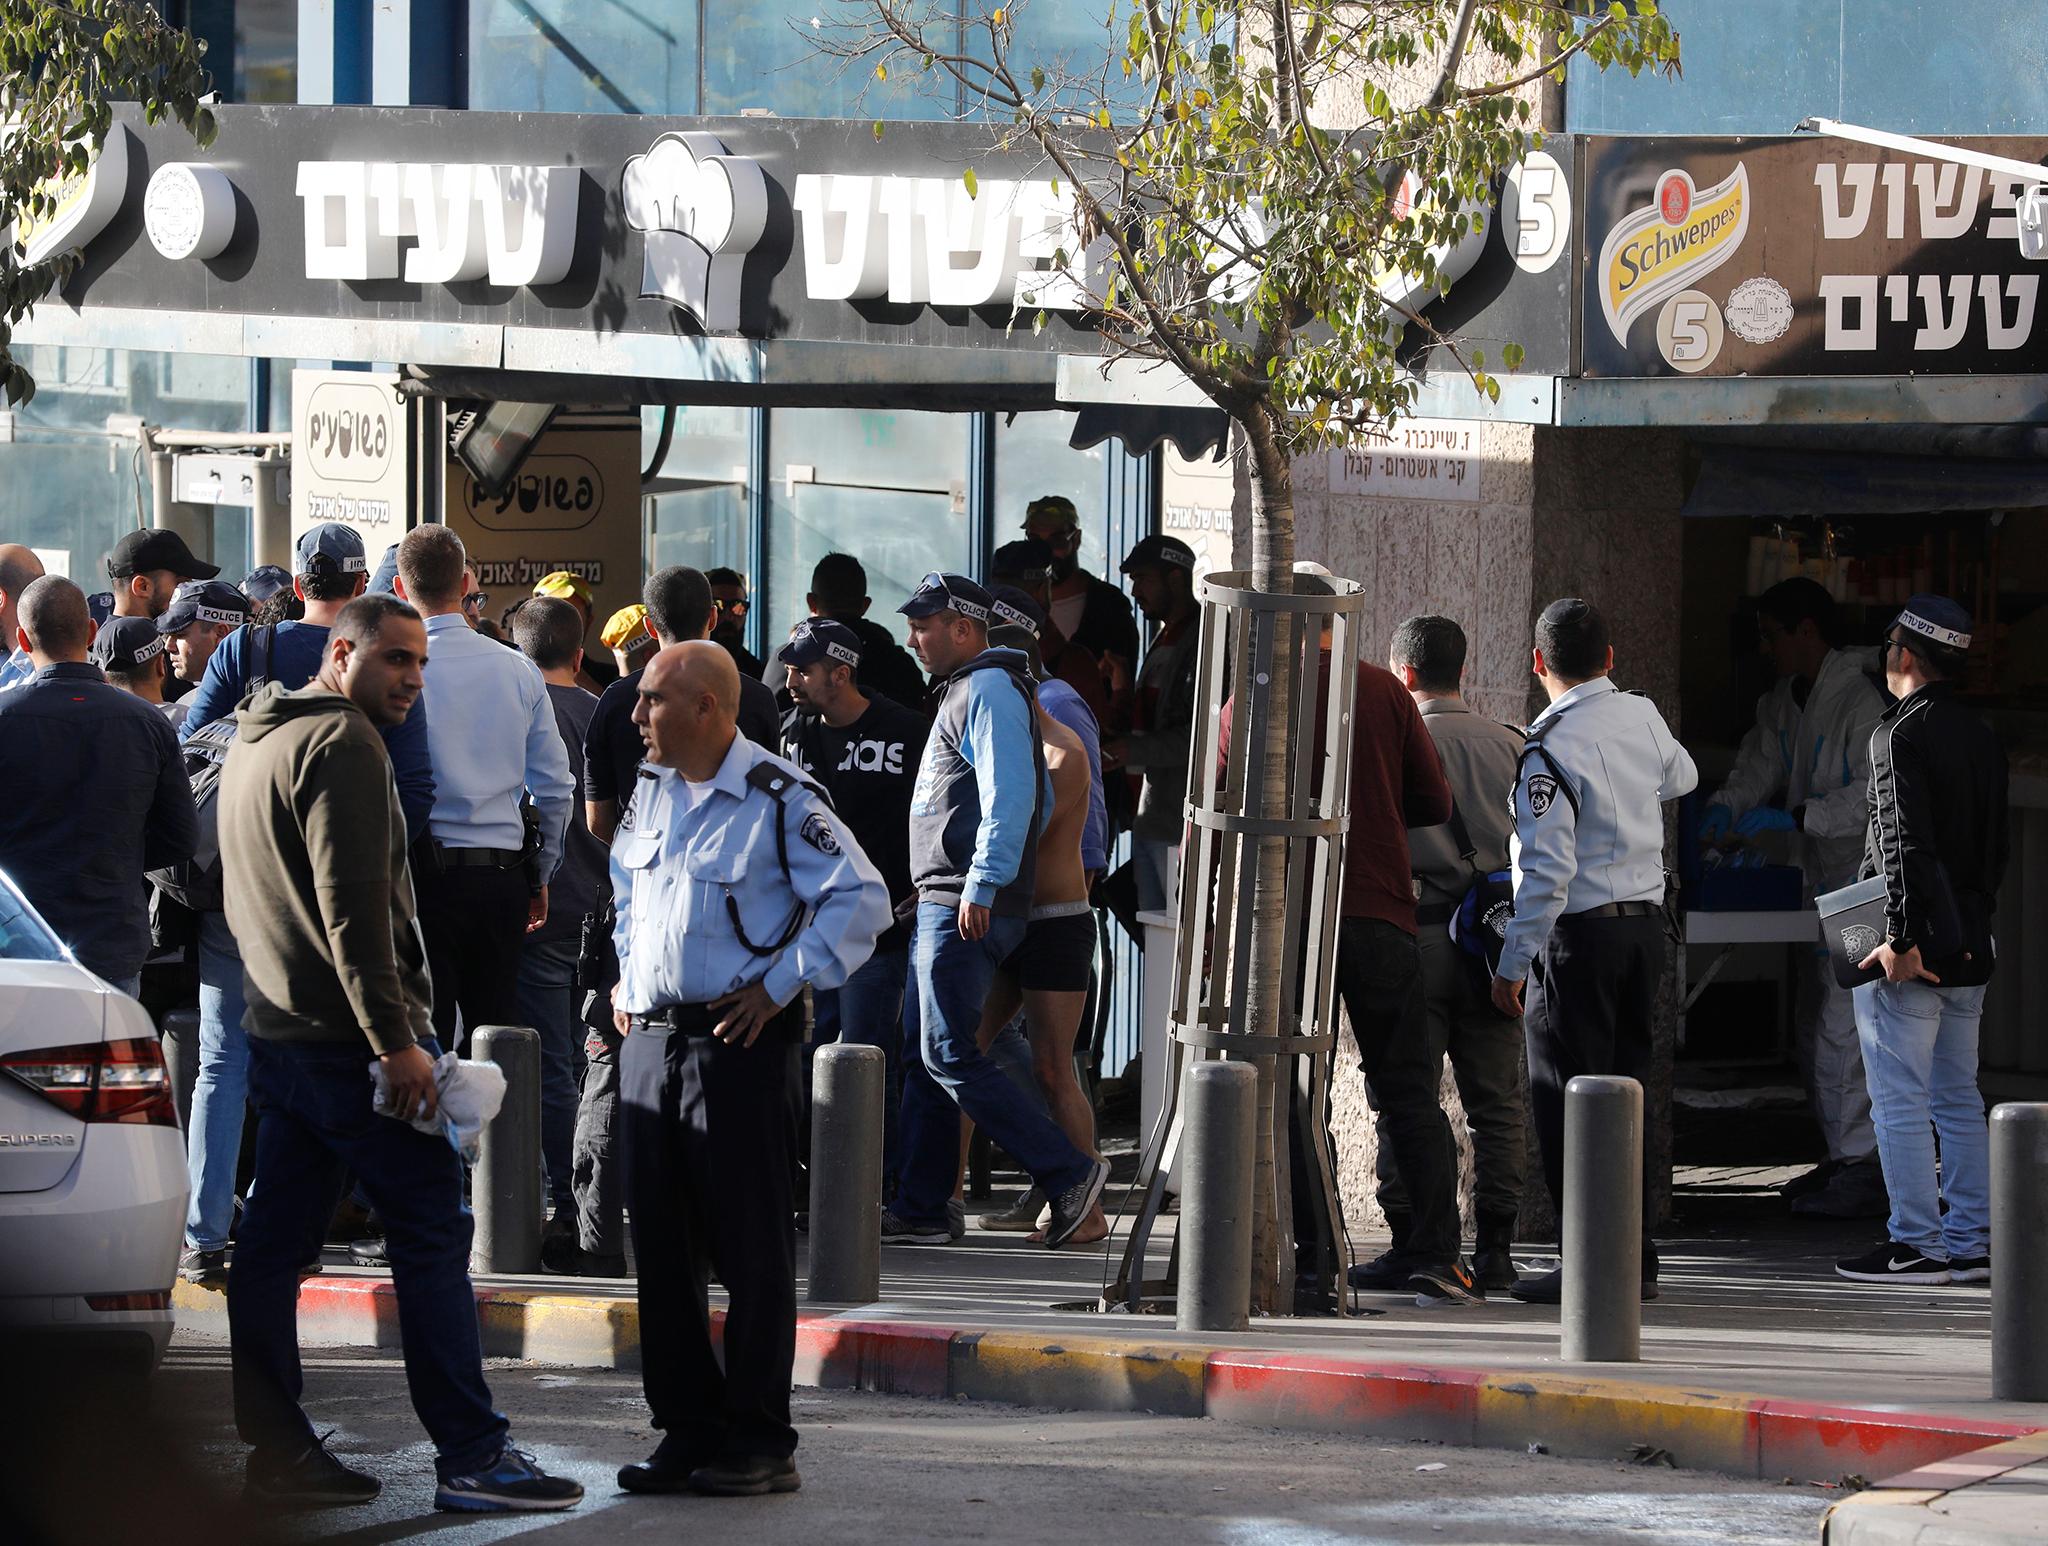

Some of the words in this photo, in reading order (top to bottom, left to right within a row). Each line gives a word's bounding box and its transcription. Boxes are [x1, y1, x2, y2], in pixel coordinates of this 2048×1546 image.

[1516, 168, 1555, 257] 5
[1813, 163, 2040, 240] פשוט
[296, 160, 581, 286] טעים
[794, 173, 1095, 309] פשוט
[1618, 204, 1735, 291] Schweppes
[1818, 274, 2040, 351] טעים
[1672, 303, 1709, 360] 5
[1404, 429, 1457, 449] שיינברג
[308, 491, 336, 519] אוכל
[337, 493, 356, 519] של
[357, 499, 390, 528] מקום
[1165, 500, 1193, 528] אוכל
[1193, 502, 1212, 530] של
[1214, 509, 1233, 538] קום
[519, 558, 546, 583] של
[203, 609, 240, 623] POLICE
[954, 600, 986, 618] POLICE
[995, 602, 1033, 630] POLICE
[1901, 612, 1935, 635] משטרה
[0, 1134, 76, 1147] SUPERB
